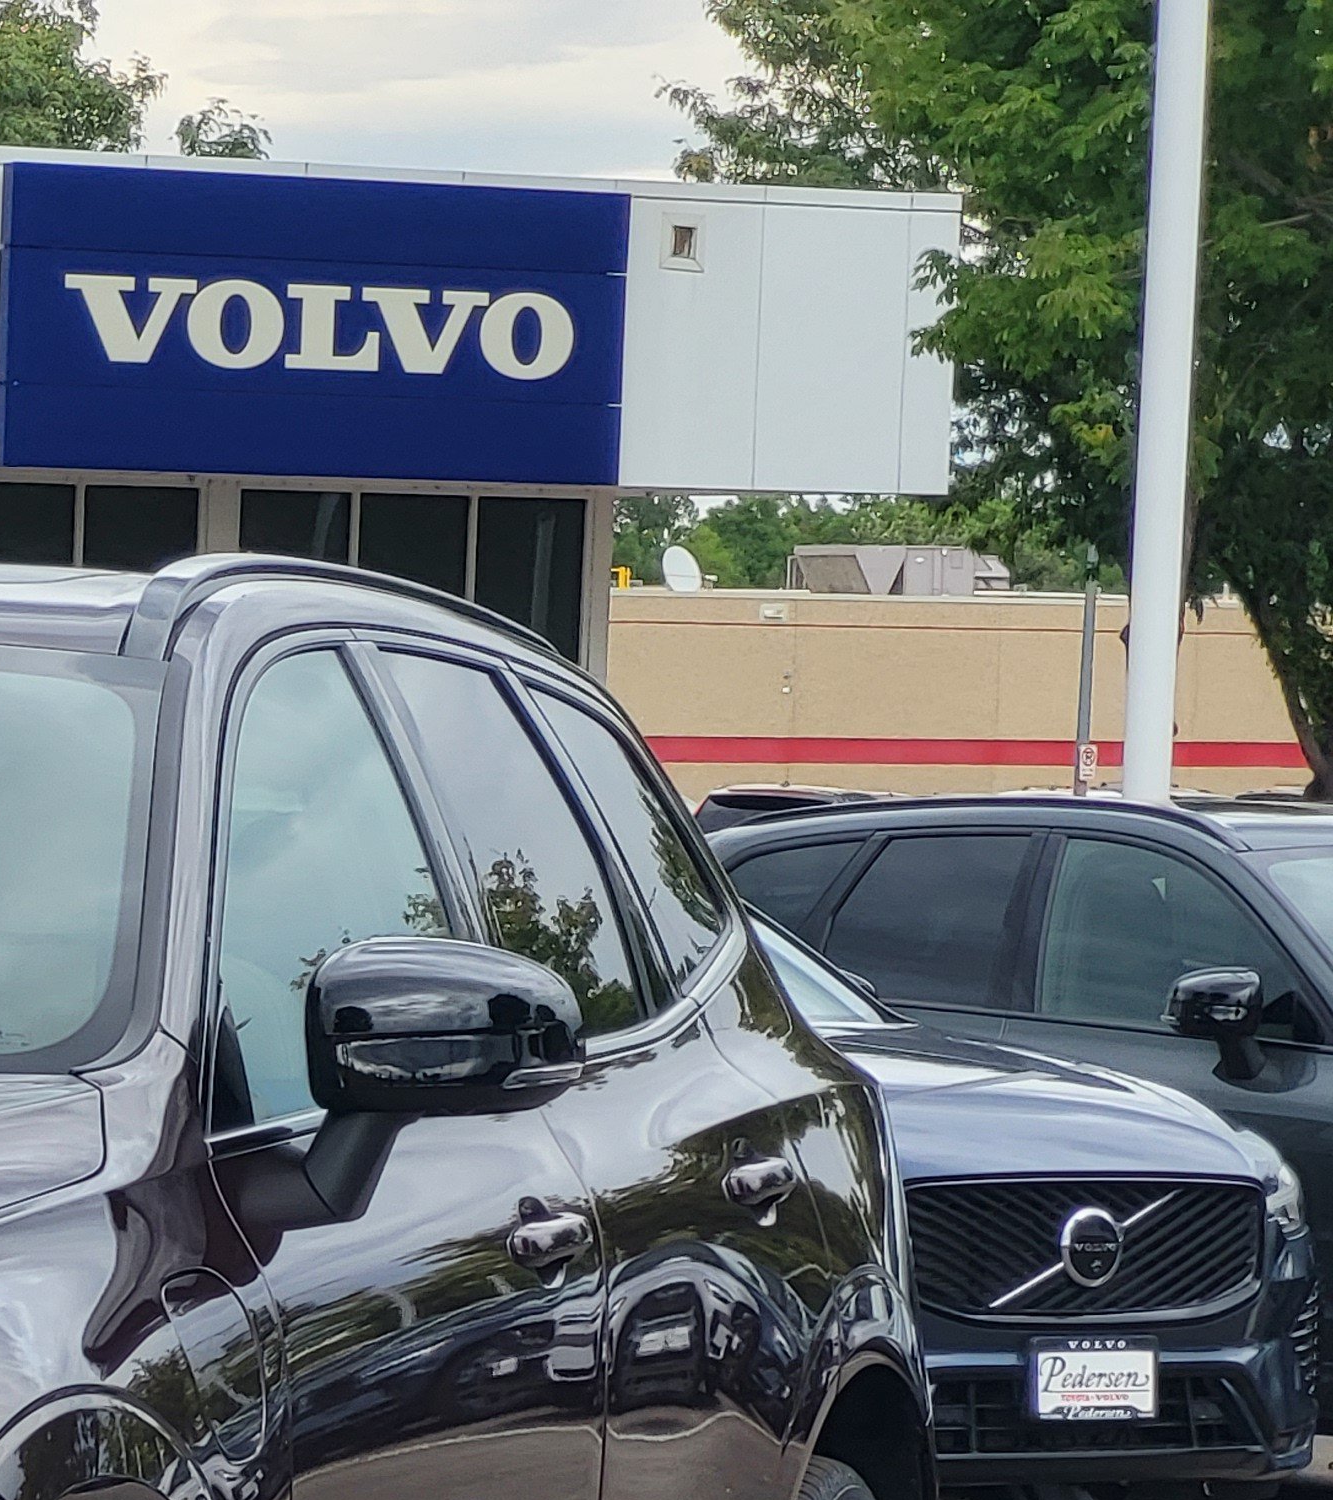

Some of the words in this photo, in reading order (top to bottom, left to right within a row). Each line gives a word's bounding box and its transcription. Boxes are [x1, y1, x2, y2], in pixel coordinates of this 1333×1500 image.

[65, 272, 575, 381] VOLVO
[1068, 1340, 1126, 1349] VOLVO
[1040, 1356, 1149, 1393] Pedersen
